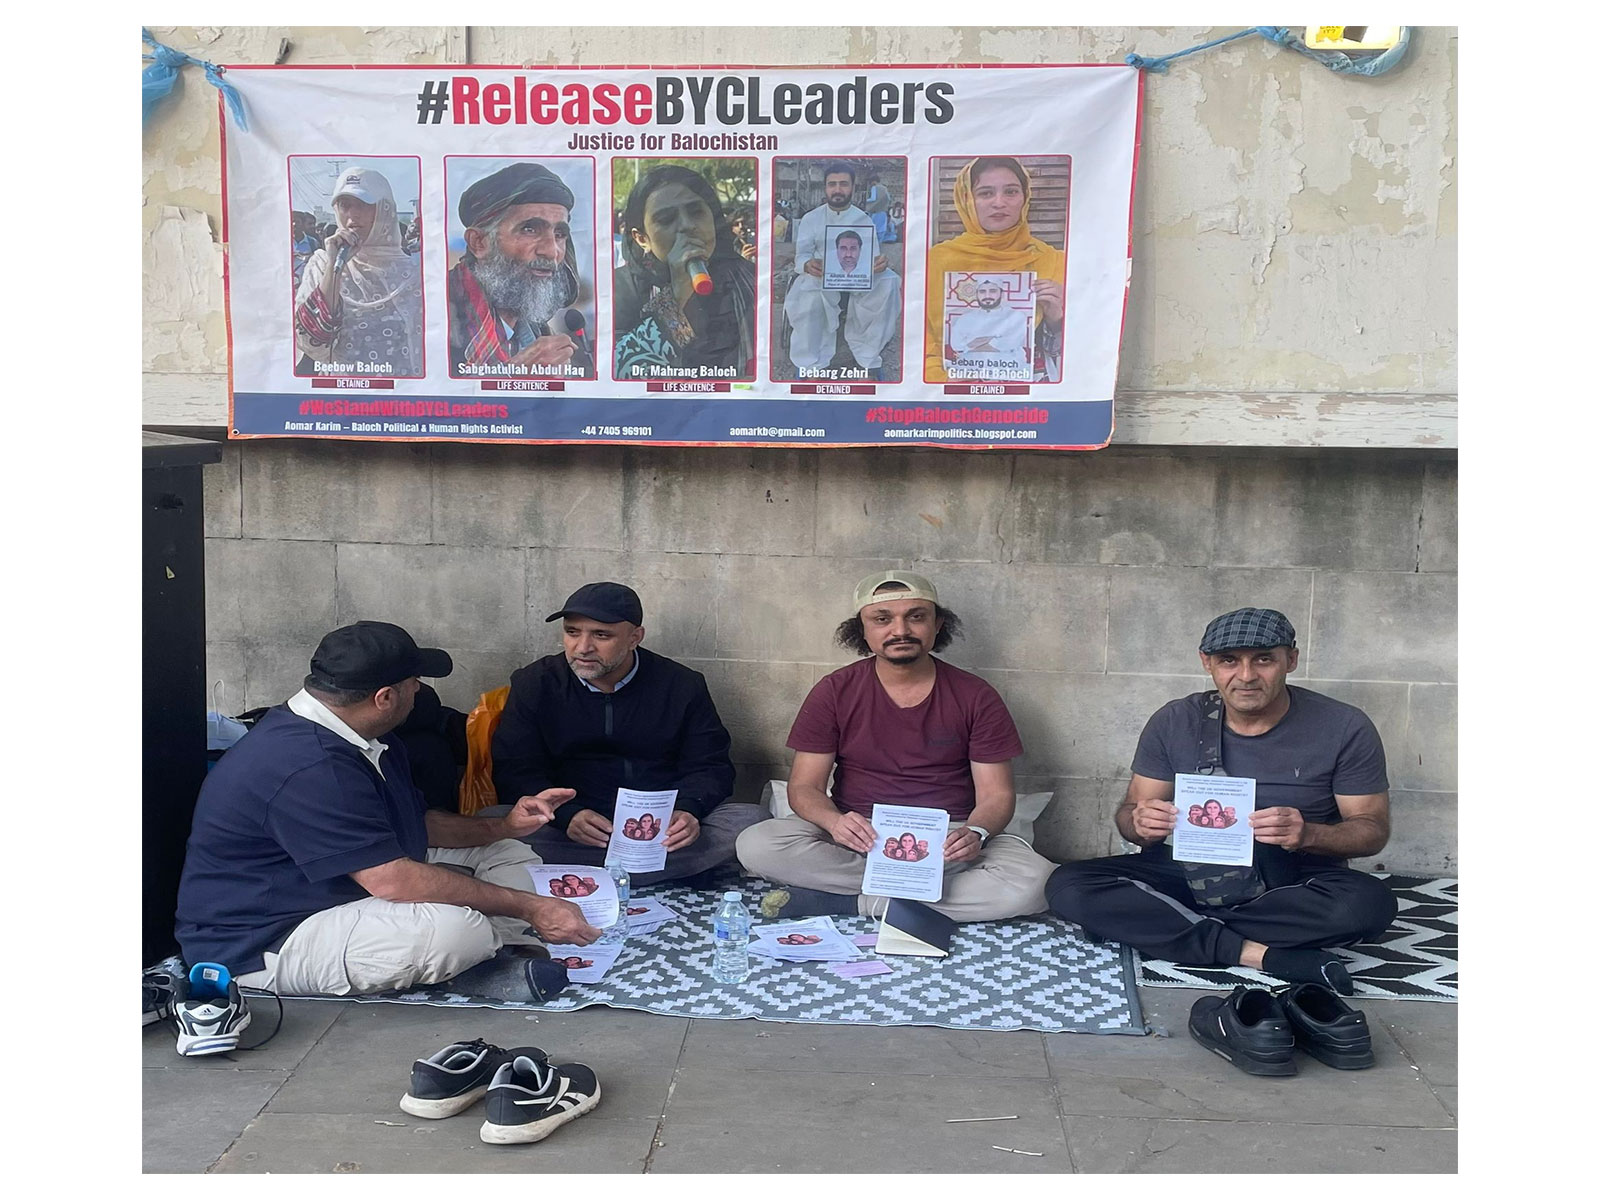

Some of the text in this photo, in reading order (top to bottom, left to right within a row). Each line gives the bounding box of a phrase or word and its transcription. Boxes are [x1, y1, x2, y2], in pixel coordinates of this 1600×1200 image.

[416, 75, 955, 126] #ReleaseBYCLeaders
[567, 132, 779, 152] Justice for Balochistan
[314, 361, 393, 374] Beebow Baloch
[987, 358, 1019, 369] baloch
[458, 363, 585, 378] Sabghatullah Abdul Haq
[632, 365, 737, 379] Dr. Mahrang Baloch
[798, 366, 869, 380] Bebarg Zehri
[947, 367, 1030, 380] Gulzadi Baloch
[336, 379, 370, 389] DETAINED
[497, 381, 549, 391] LIFE SENTENCE
[662, 382, 715, 392] LIFE SENTENCE
[816, 384, 851, 394] DETAINED
[970, 385, 1005, 395] DETAINED
[299, 400, 509, 419] #WeStandWithBYCLeaders
[865, 406, 1049, 426] #StopBalochGenocide
[284, 421, 314, 432] Aomar
[315, 421, 342, 432] Karim
[351, 421, 382, 433] Baloch
[383, 422, 420, 433] Political
[421, 423, 428, 433] &
[429, 423, 459, 434] Human
[460, 423, 489, 435] Rights
[490, 424, 524, 435] Activist
[581, 425, 652, 436] +44 7405 969101
[729, 426, 826, 438] aomarkb@gmail.com
[884, 427, 1038, 441] aomarkarimpolitics.blogspot.com
